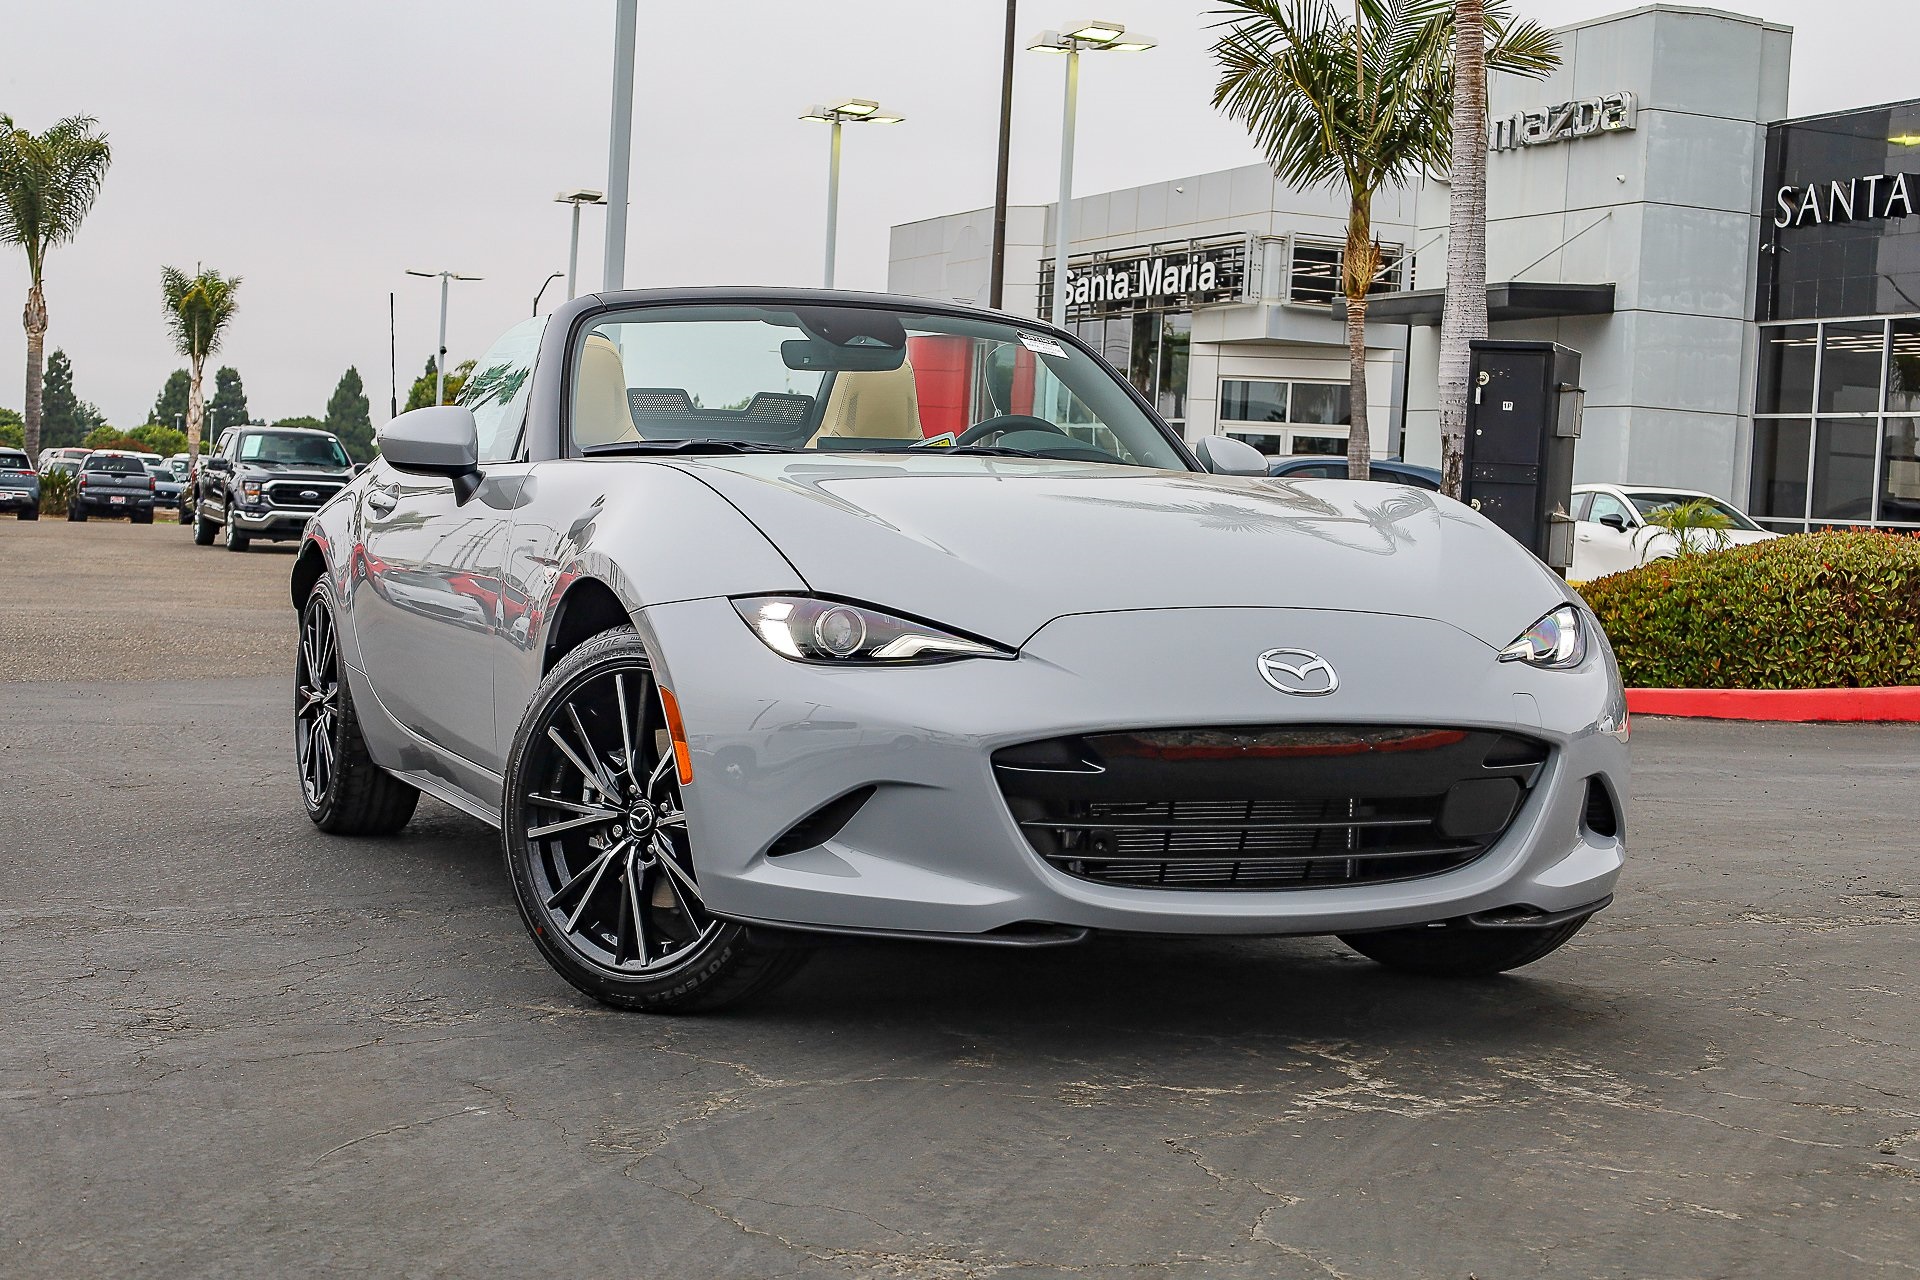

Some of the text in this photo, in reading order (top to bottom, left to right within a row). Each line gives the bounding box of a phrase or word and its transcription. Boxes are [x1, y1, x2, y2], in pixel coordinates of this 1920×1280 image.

[1774, 172, 1913, 228] SANTA
[1064, 255, 1216, 306] Santa Maria
[648, 945, 733, 1002] POTENZA
